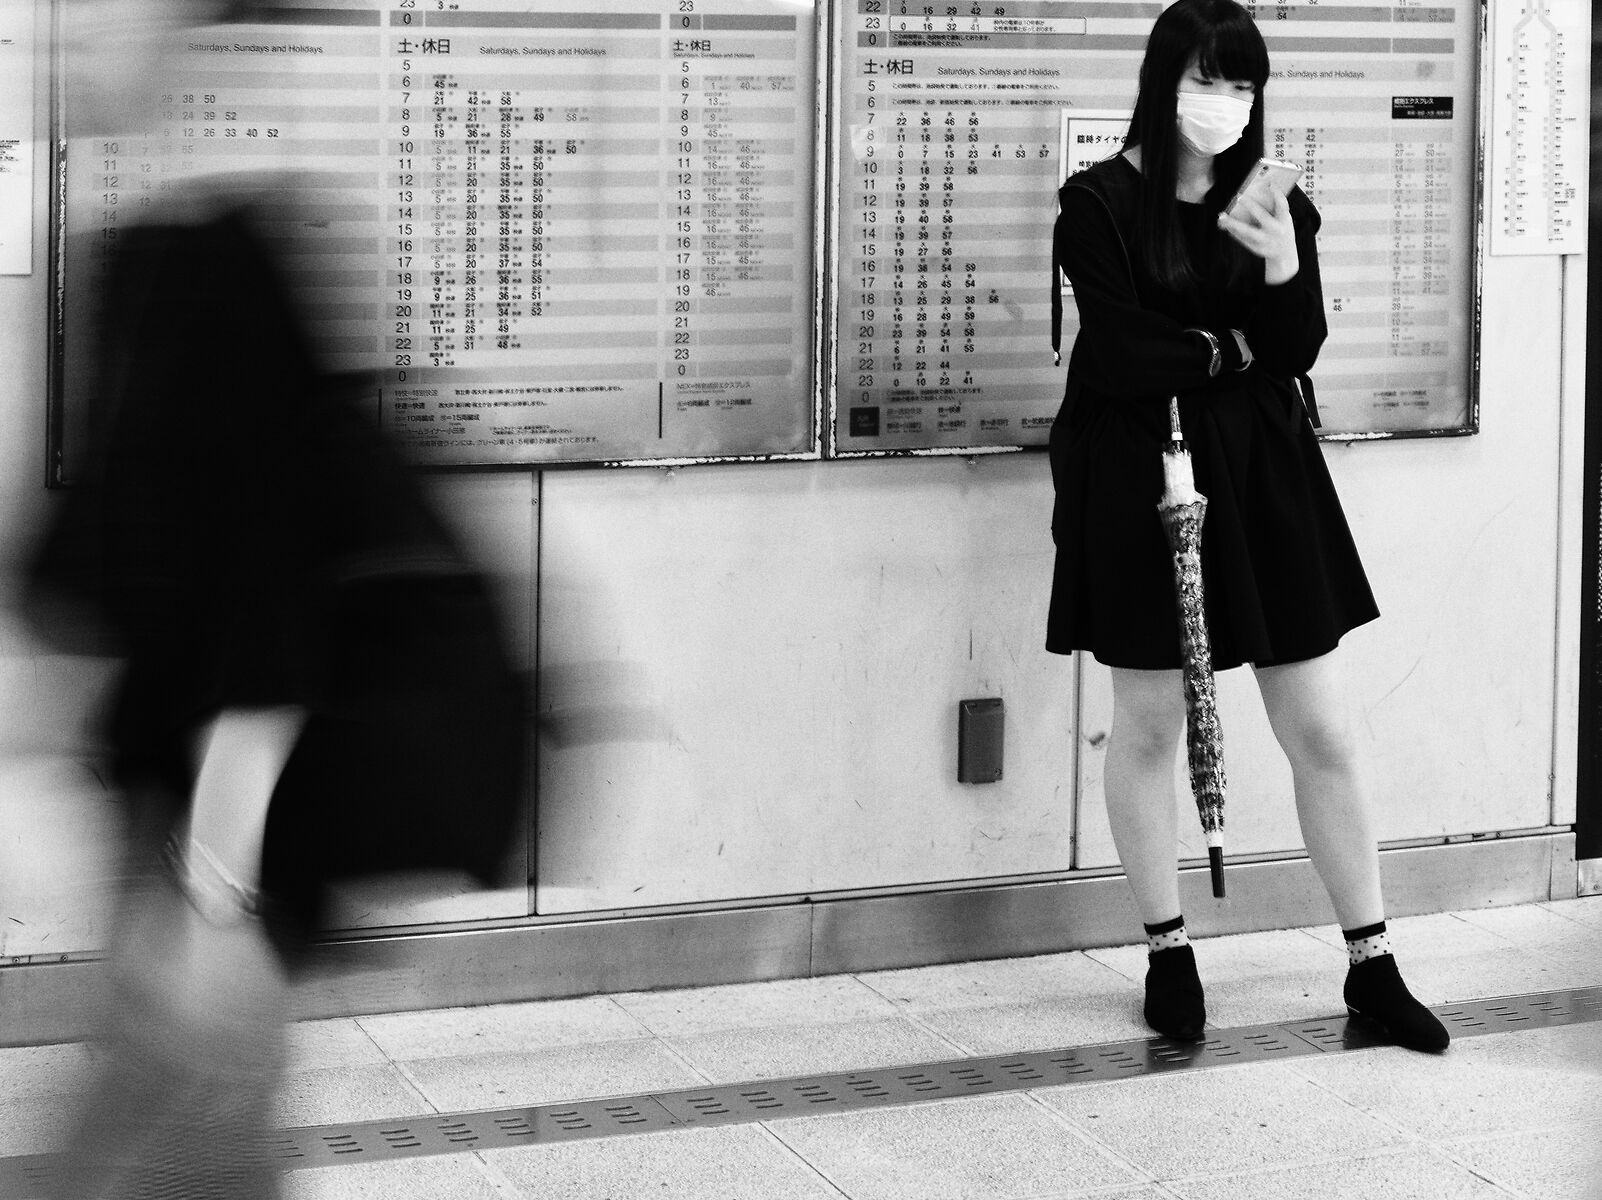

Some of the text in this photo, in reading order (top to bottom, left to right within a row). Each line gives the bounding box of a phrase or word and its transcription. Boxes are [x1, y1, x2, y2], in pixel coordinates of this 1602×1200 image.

[438, 2, 444, 10] 3
[866, 2, 1005, 16] 22 0 16 29 42 49
[403, 14, 411, 24] 0
[188, 42, 323, 54] Saturdays, Sundays and Holidays
[398, 38, 606, 56] 土・休日 Saturdays, Sundays and Holidays
[673, 40, 711, 51] 土・休日
[864, 59, 1060, 77] 土・休日 Saturdays, Sundays and Holidays
[1287, 71, 1318, 79] Sundays
[1335, 71, 1365, 79] Holidays
[1275, 134, 1315, 142] 35 42
[859, 376, 973, 387] 23 0 10 22 41
